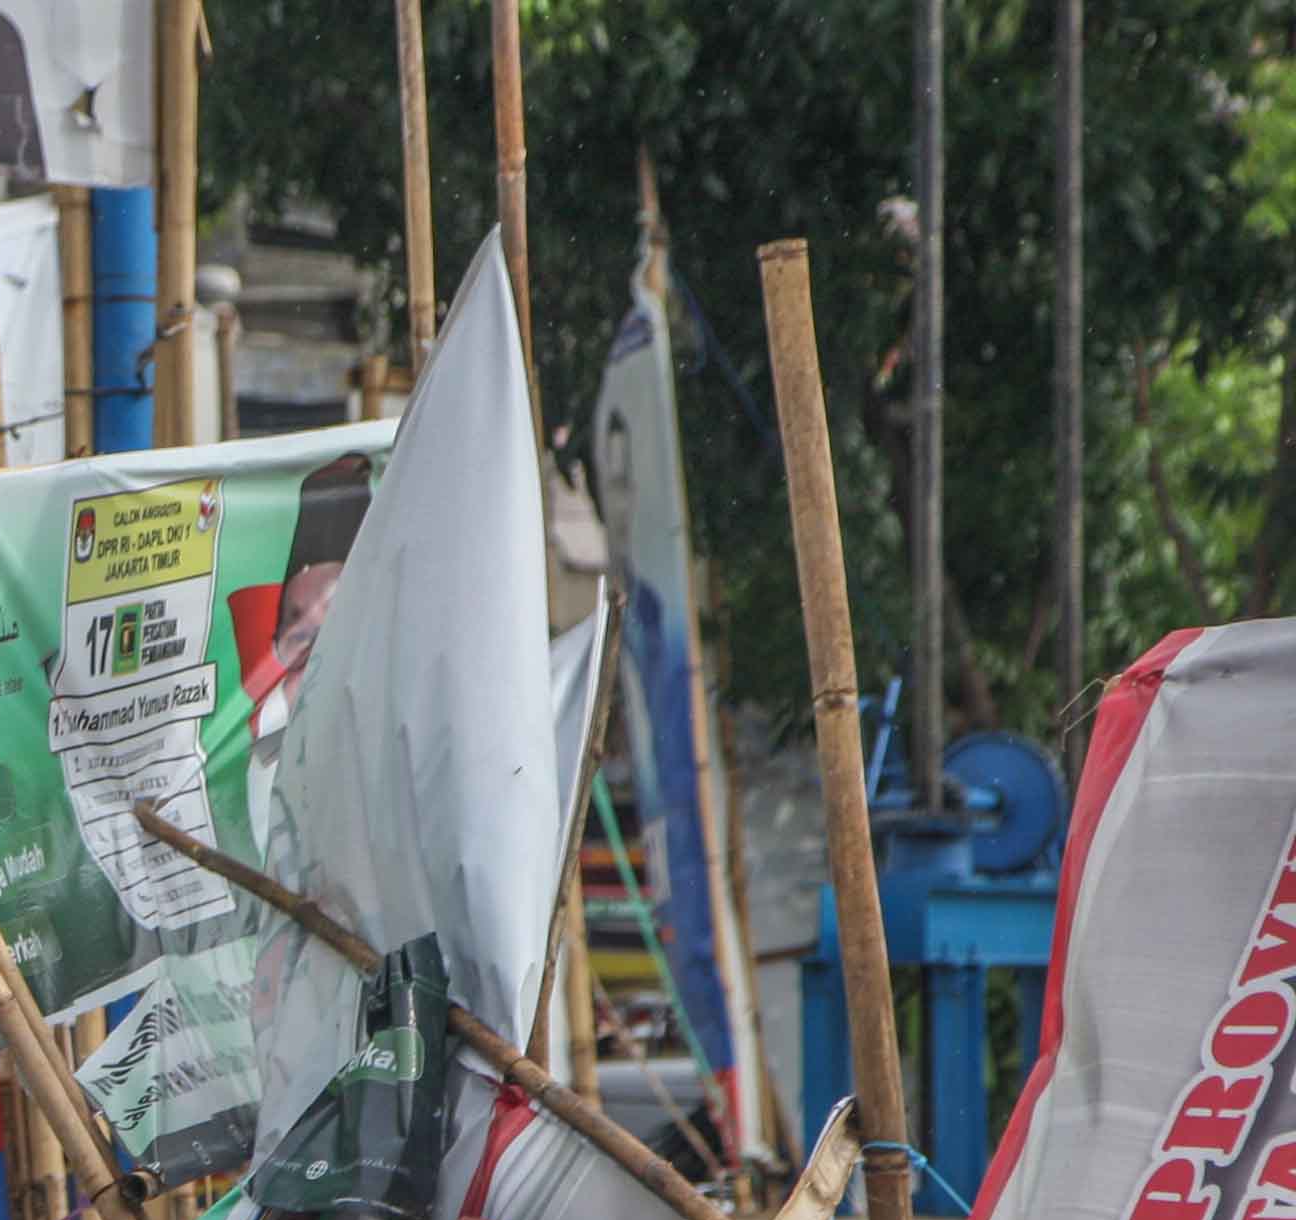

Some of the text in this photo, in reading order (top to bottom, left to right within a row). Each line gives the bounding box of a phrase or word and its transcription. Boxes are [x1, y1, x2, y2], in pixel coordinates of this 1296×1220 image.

[96, 538, 118, 560] DPR
[138, 530, 165, 553] DAPIL
[104, 548, 182, 583] JAKARTA TIMUR
[85, 615, 115, 677] 17
[136, 693, 169, 719] Yunus
[172, 676, 210, 707] Razak
